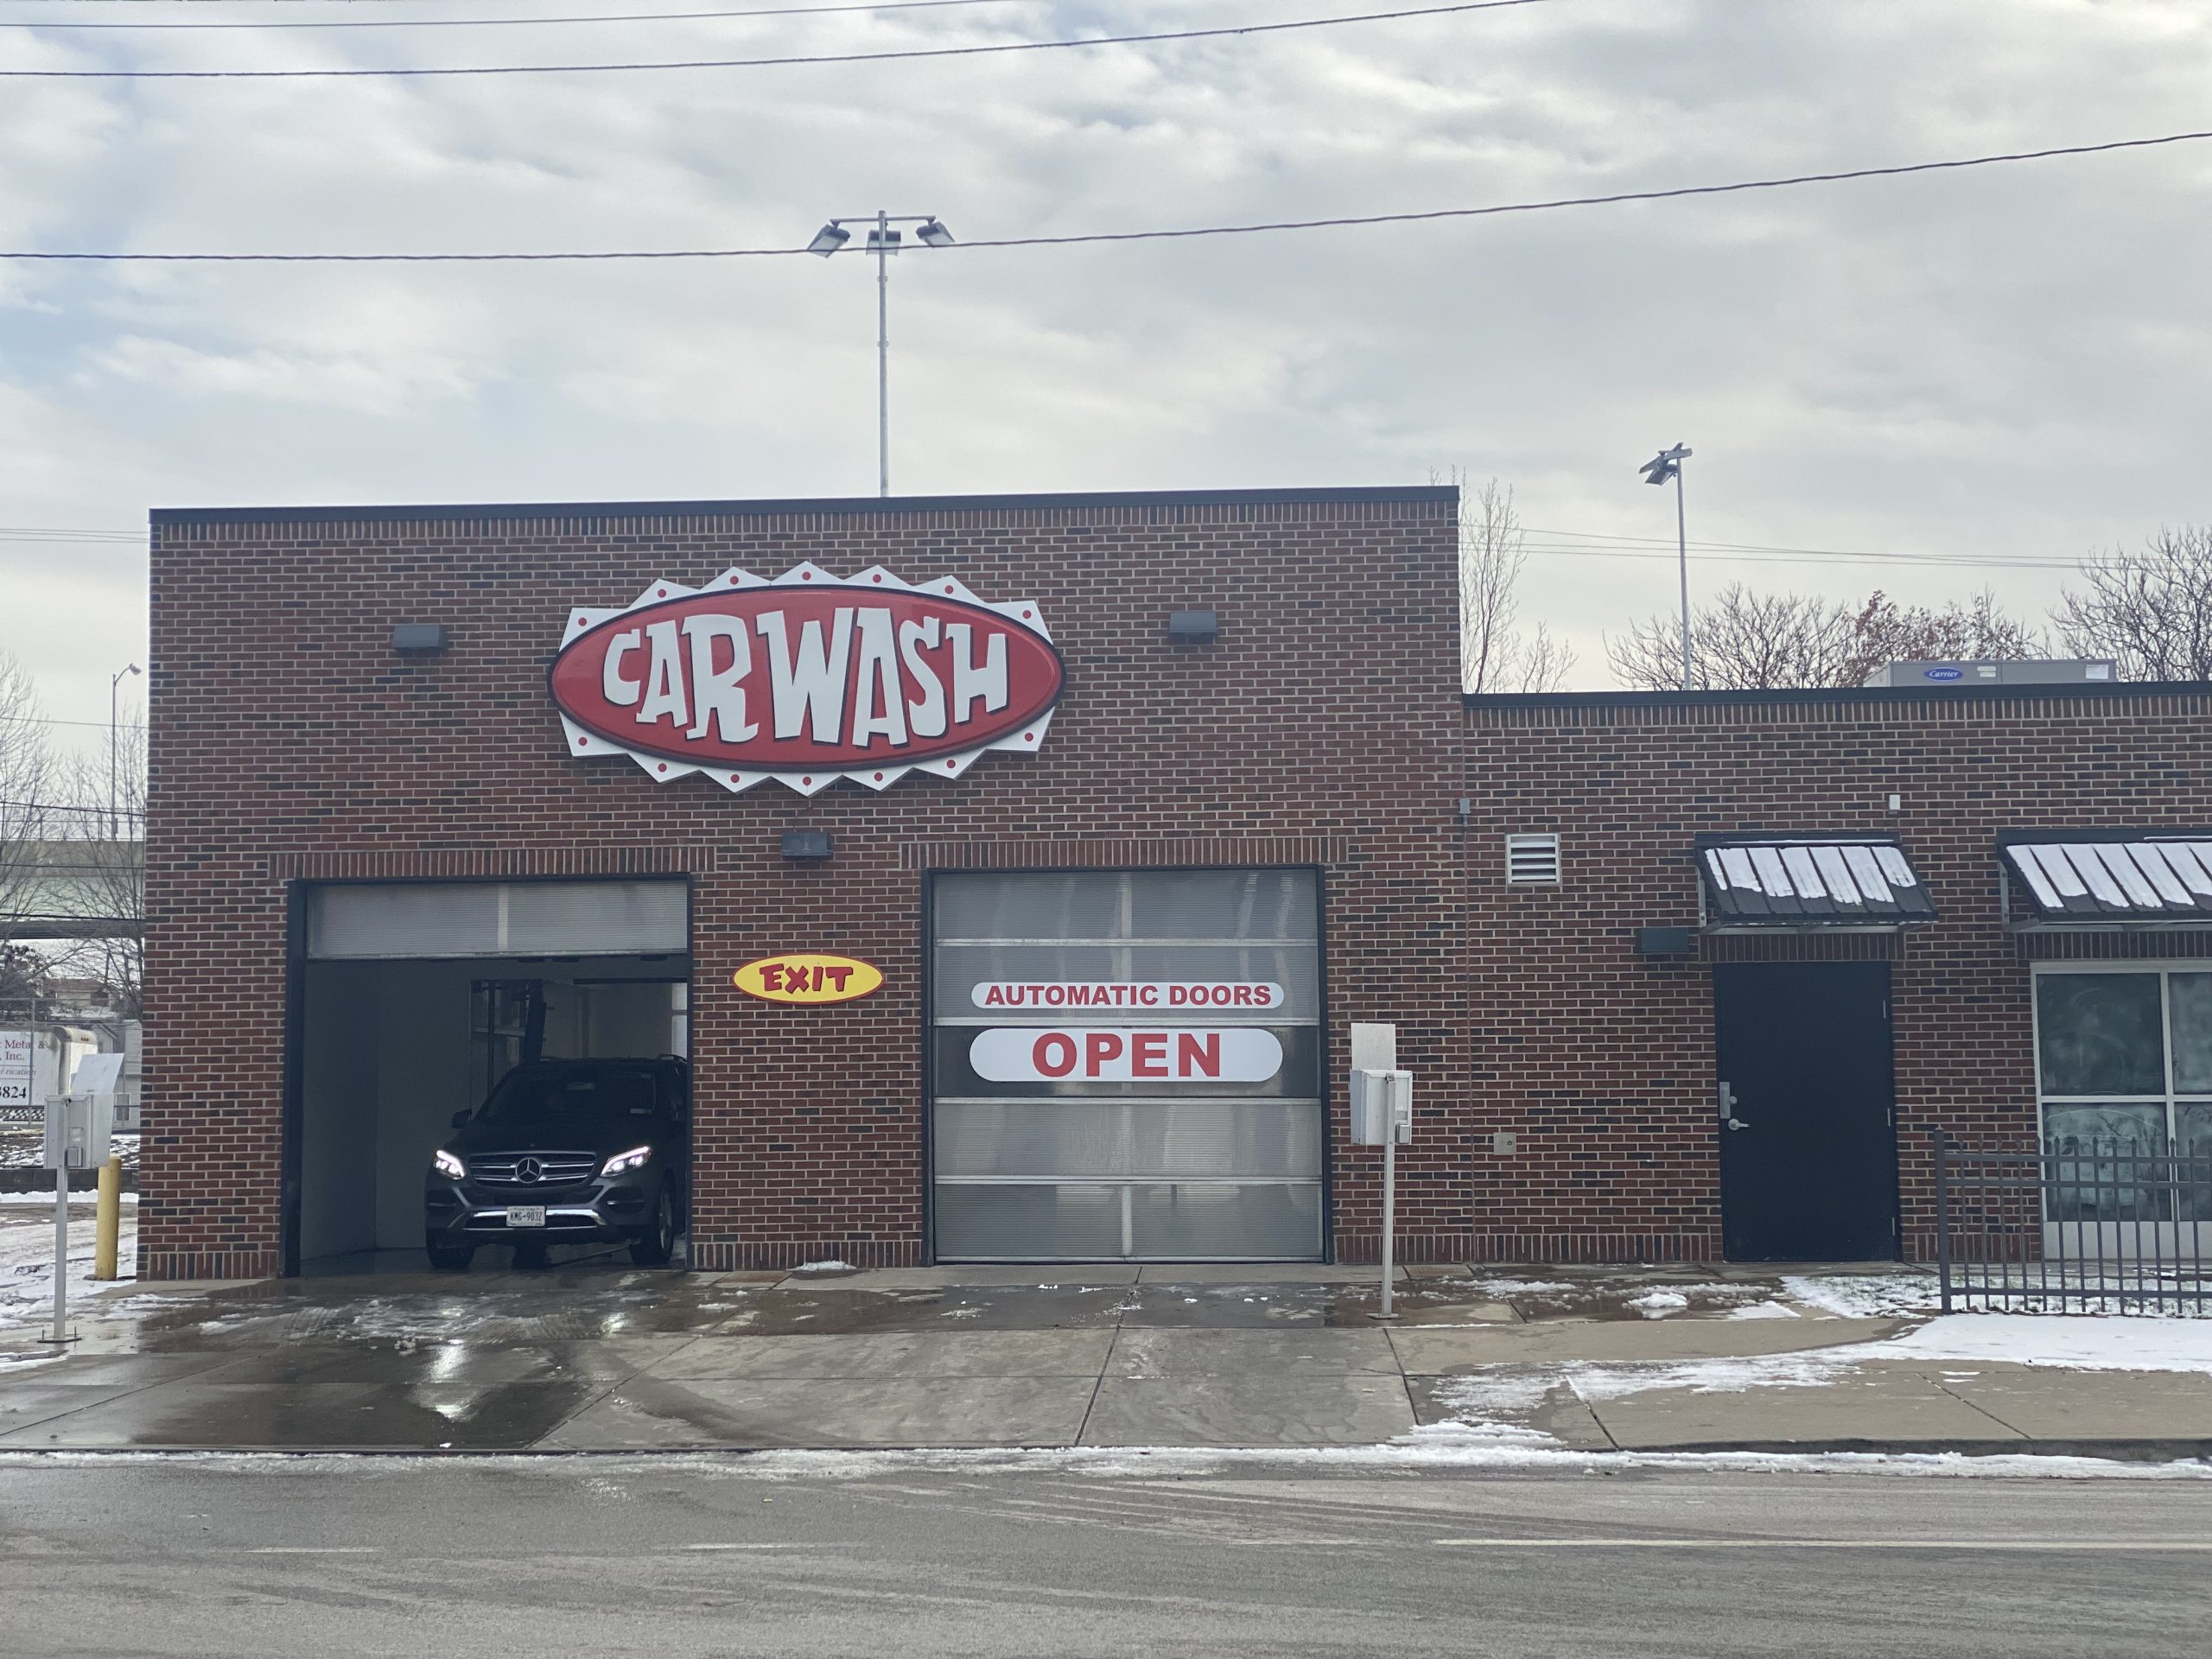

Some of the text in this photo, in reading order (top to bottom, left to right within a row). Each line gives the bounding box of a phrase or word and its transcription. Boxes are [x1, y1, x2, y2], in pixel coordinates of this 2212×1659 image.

[1929, 670, 1959, 678] Carrier
[759, 963, 854, 995] EXIT
[984, 984, 1272, 1007] AUTOMATIC DOORS
[4, 1039, 35, 1050] Meta
[5, 1051, 24, 1061] Inc.
[1032, 1032, 1221, 1078] OPEN
[0, 1085, 27, 1099] 824
